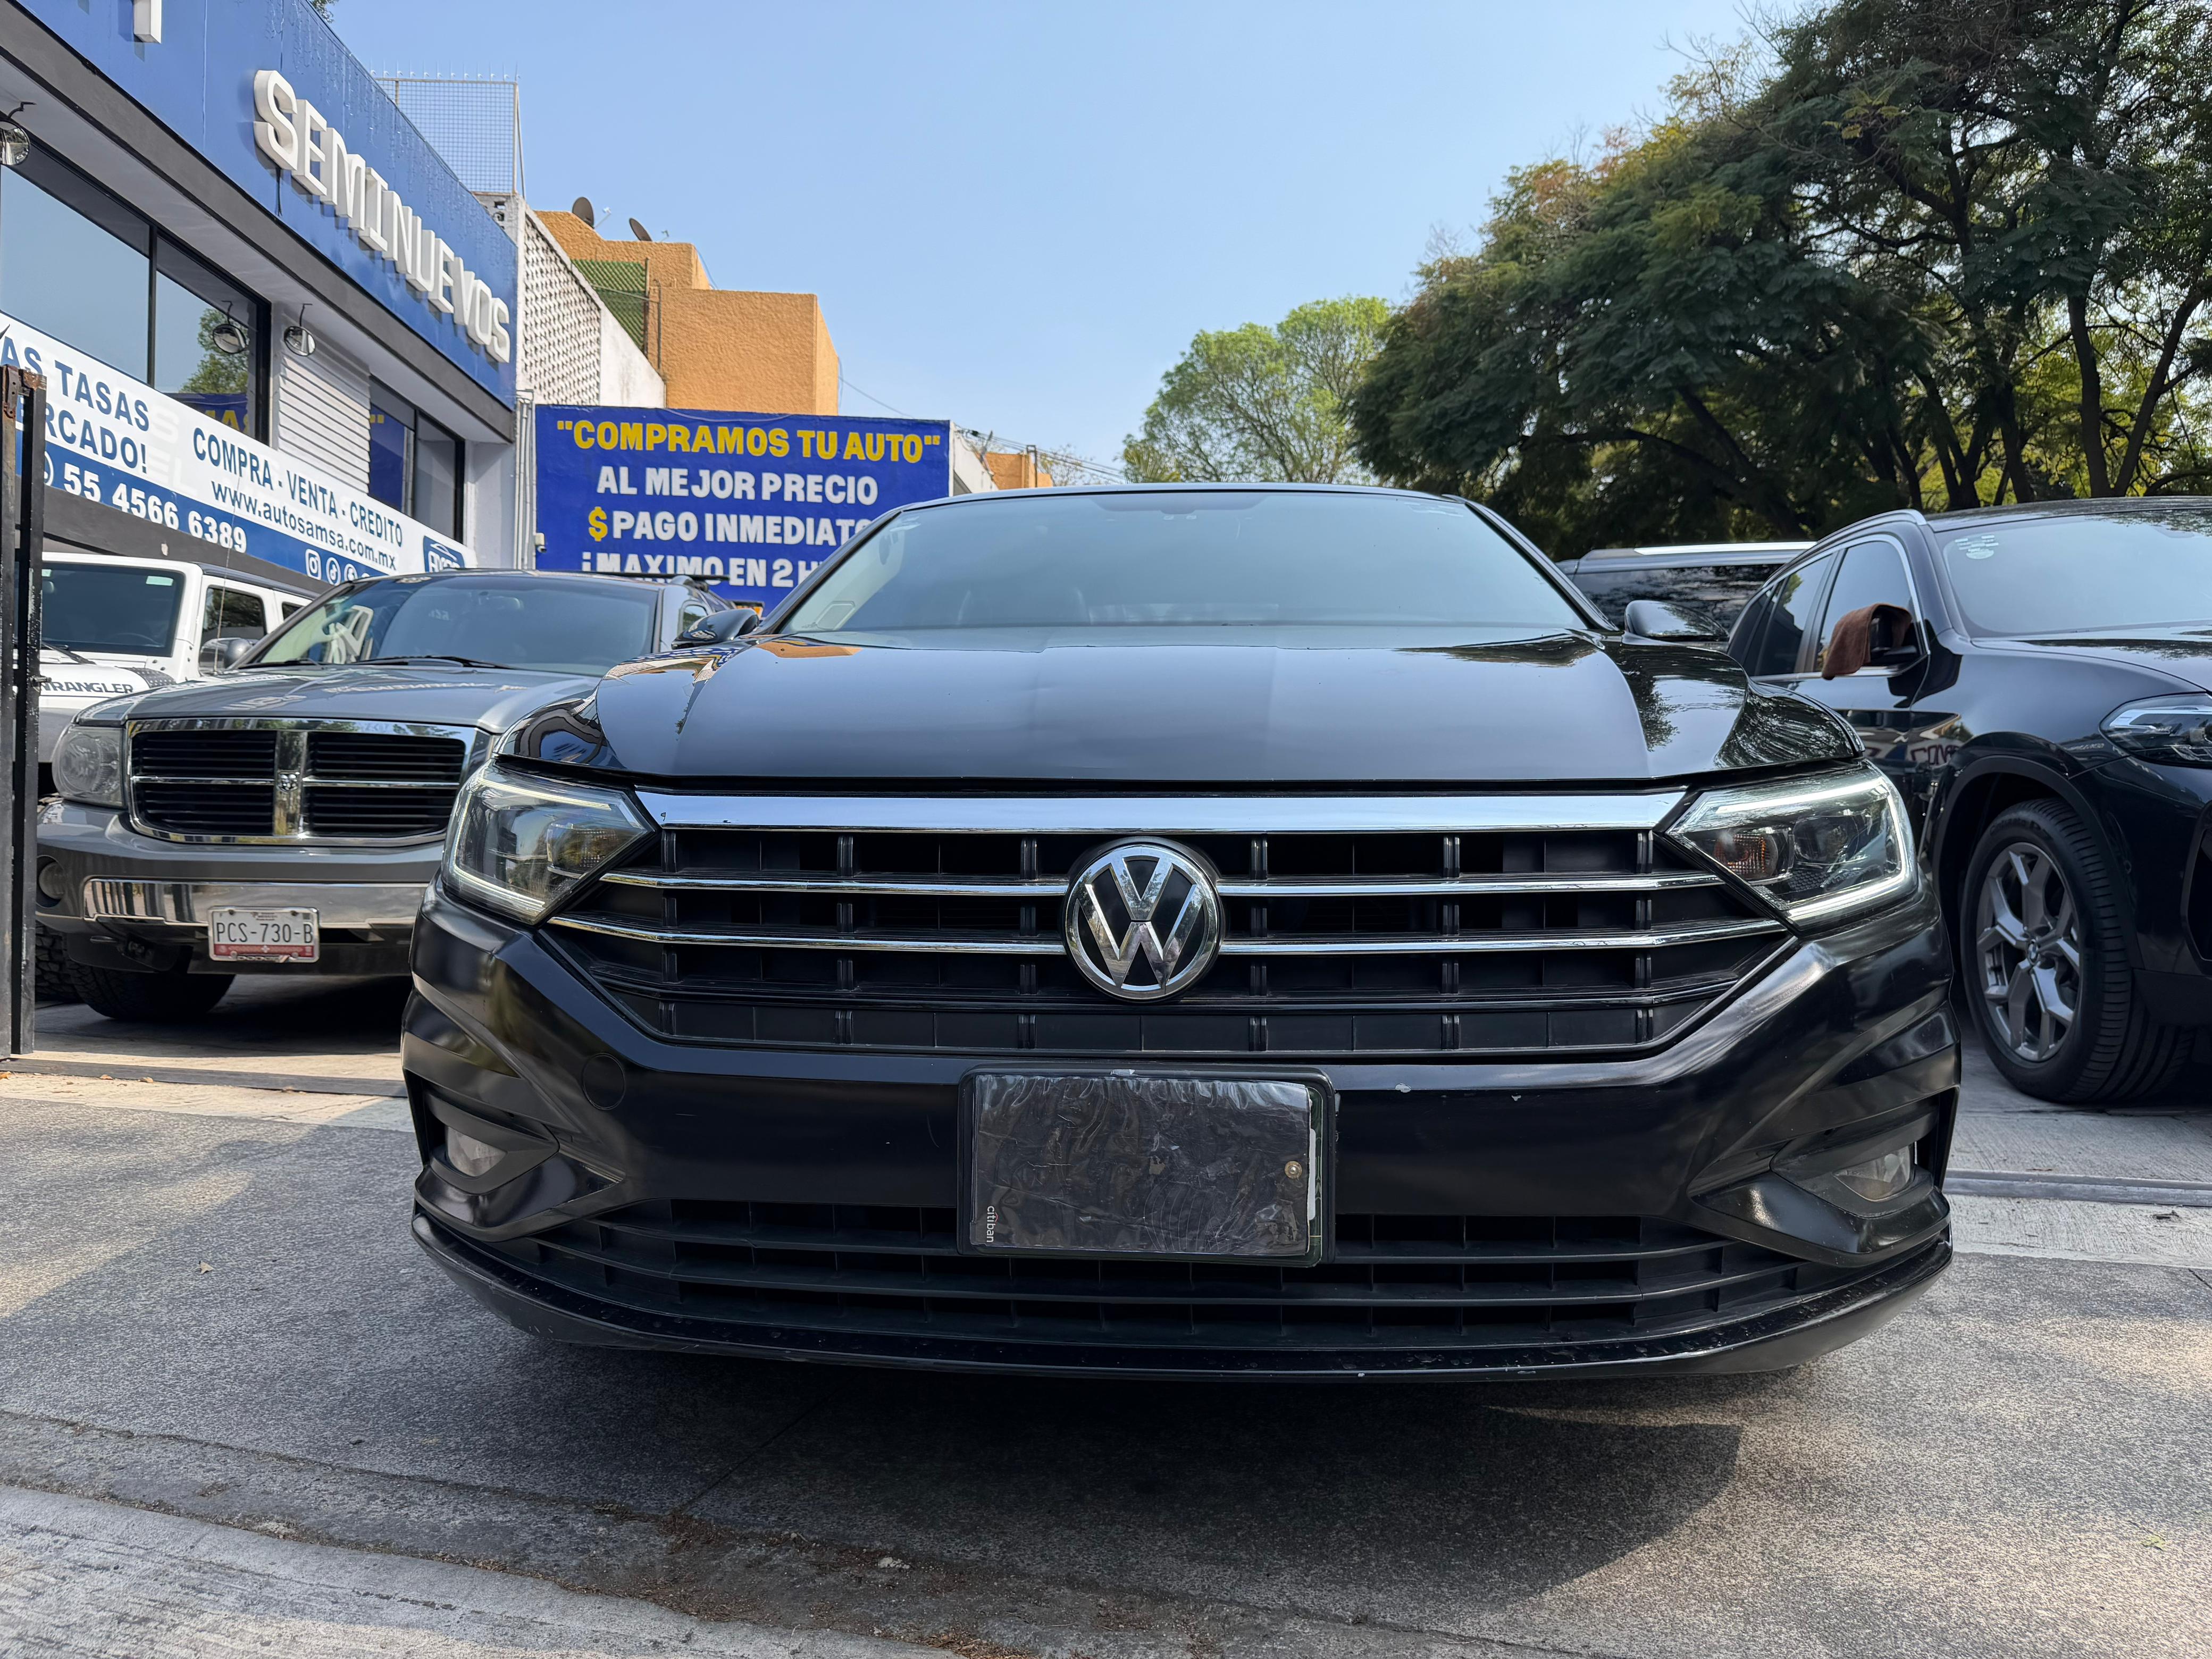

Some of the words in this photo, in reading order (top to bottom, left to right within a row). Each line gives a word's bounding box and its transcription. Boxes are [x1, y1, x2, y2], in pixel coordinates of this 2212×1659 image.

[253, 70, 510, 363] SEMINUEVOS
[55, 359, 149, 432] TASAS
[18, 395, 147, 474] RCADO!
[797, 430, 838, 460] TU
[63, 463, 101, 502] 55
[112, 482, 179, 530] 4566
[188, 510, 247, 554] 6389
[194, 428, 273, 491] COMPRA
[287, 470, 338, 519] VENTA
[350, 501, 403, 547] CREDITO
[597, 466, 637, 495] AL
[645, 467, 755, 500] MEJOR
[761, 473, 878, 506] PRECIO
[211, 481, 397, 571] www.autosamsa.com.mx
[729, 558, 767, 587] EN
[772, 558, 794, 588] 2
[216, 923, 313, 943] PCS-730-B
